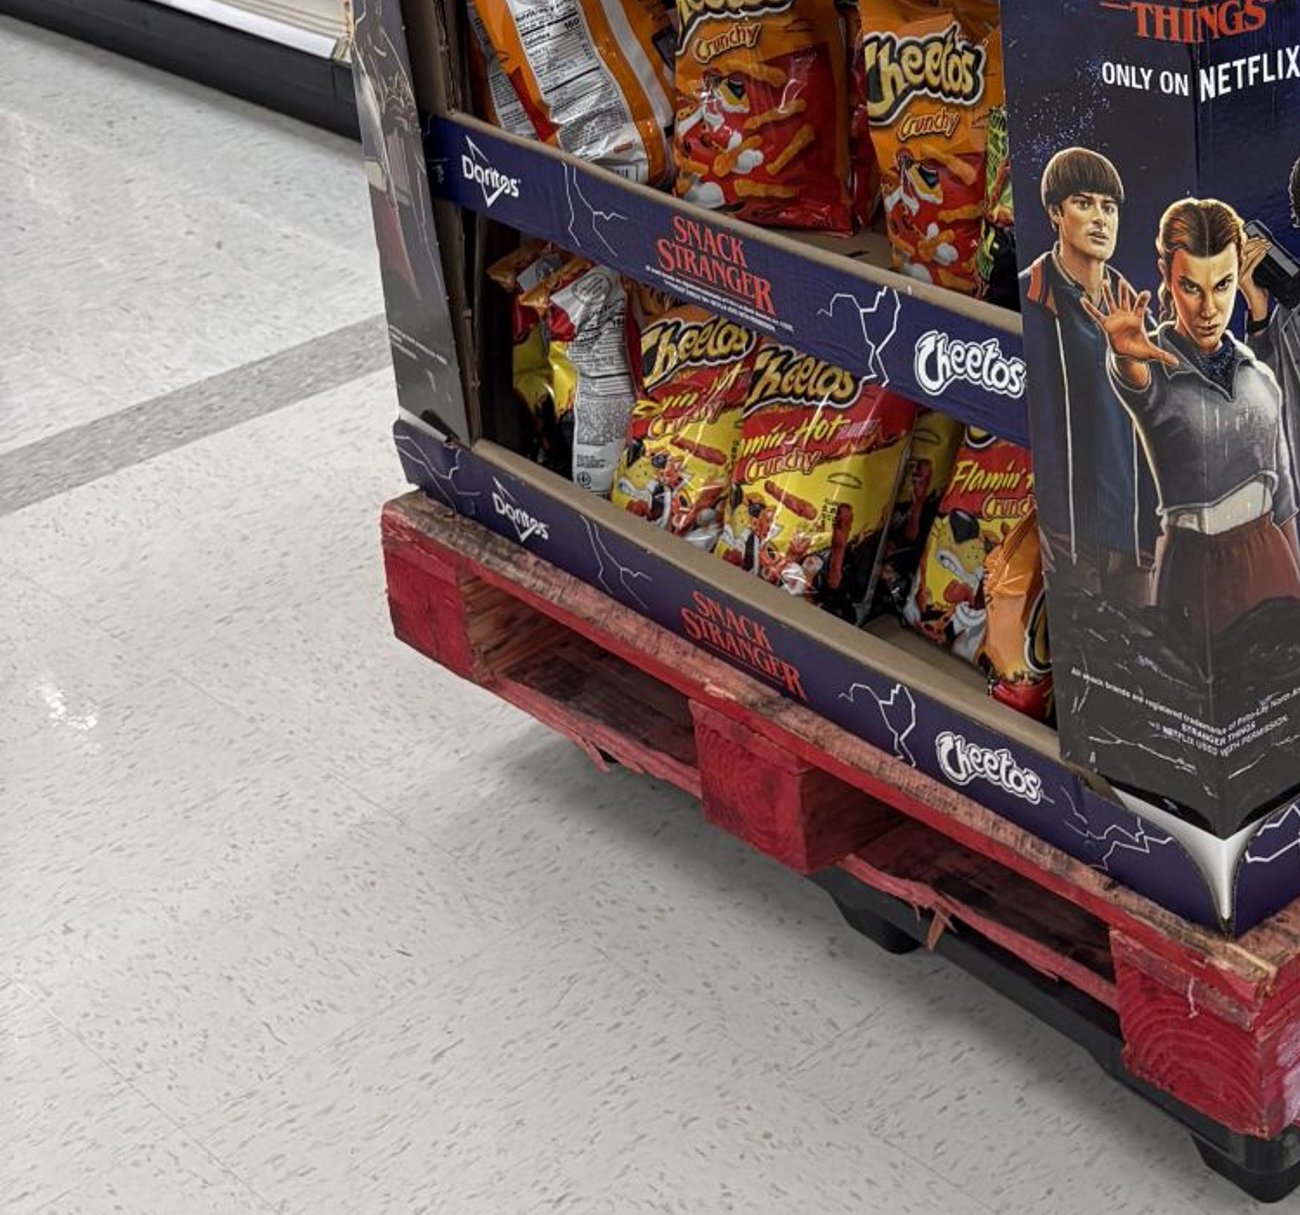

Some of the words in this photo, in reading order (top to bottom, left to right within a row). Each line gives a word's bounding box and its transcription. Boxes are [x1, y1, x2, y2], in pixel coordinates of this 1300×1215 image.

[693, 22, 762, 64] Crunchy
[1102, 61, 1153, 91] ONLY
[1160, 69, 1190, 97] ON
[1199, 45, 1300, 103] NETFLIX
[900, 106, 961, 142] Crunchy
[461, 153, 521, 198] Doritos
[671, 214, 749, 269] SNACK
[656, 237, 777, 316] STRANGER
[914, 330, 1027, 399] Cheetos
[797, 413, 851, 444] Hot
[745, 447, 822, 481] Crunchy
[948, 459, 1024, 492] Flamin'
[491, 491, 550, 541] Doritos
[692, 590, 773, 653] SNACK
[681, 609, 808, 702] STRANGER
[935, 731, 1043, 806] Cheetos
